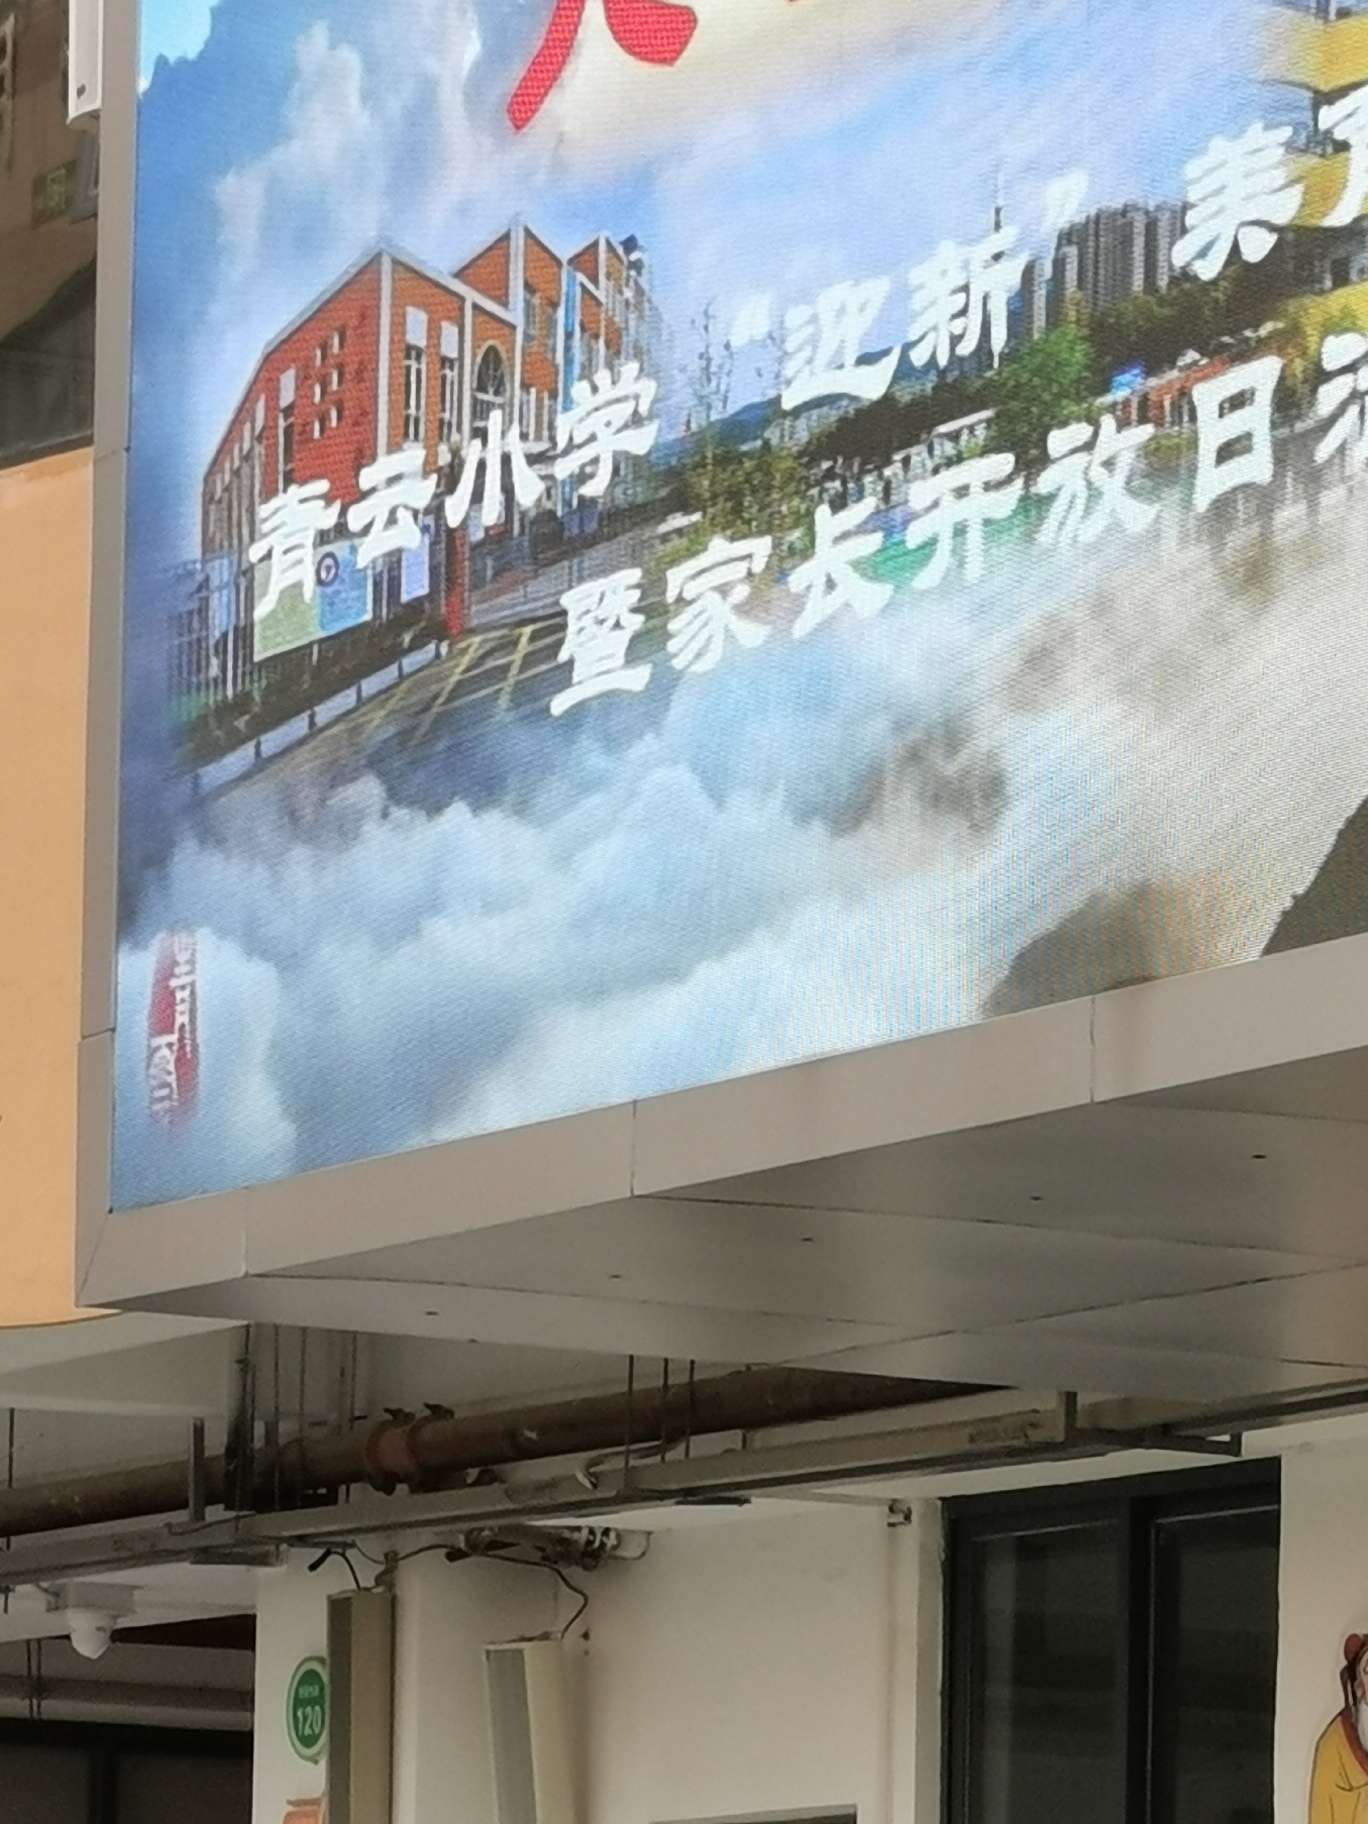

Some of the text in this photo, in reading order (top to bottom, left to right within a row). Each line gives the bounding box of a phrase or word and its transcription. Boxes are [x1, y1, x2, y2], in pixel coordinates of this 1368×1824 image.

[249, 360, 658, 620] 青云小学
[297, 1705, 322, 1737] 120
